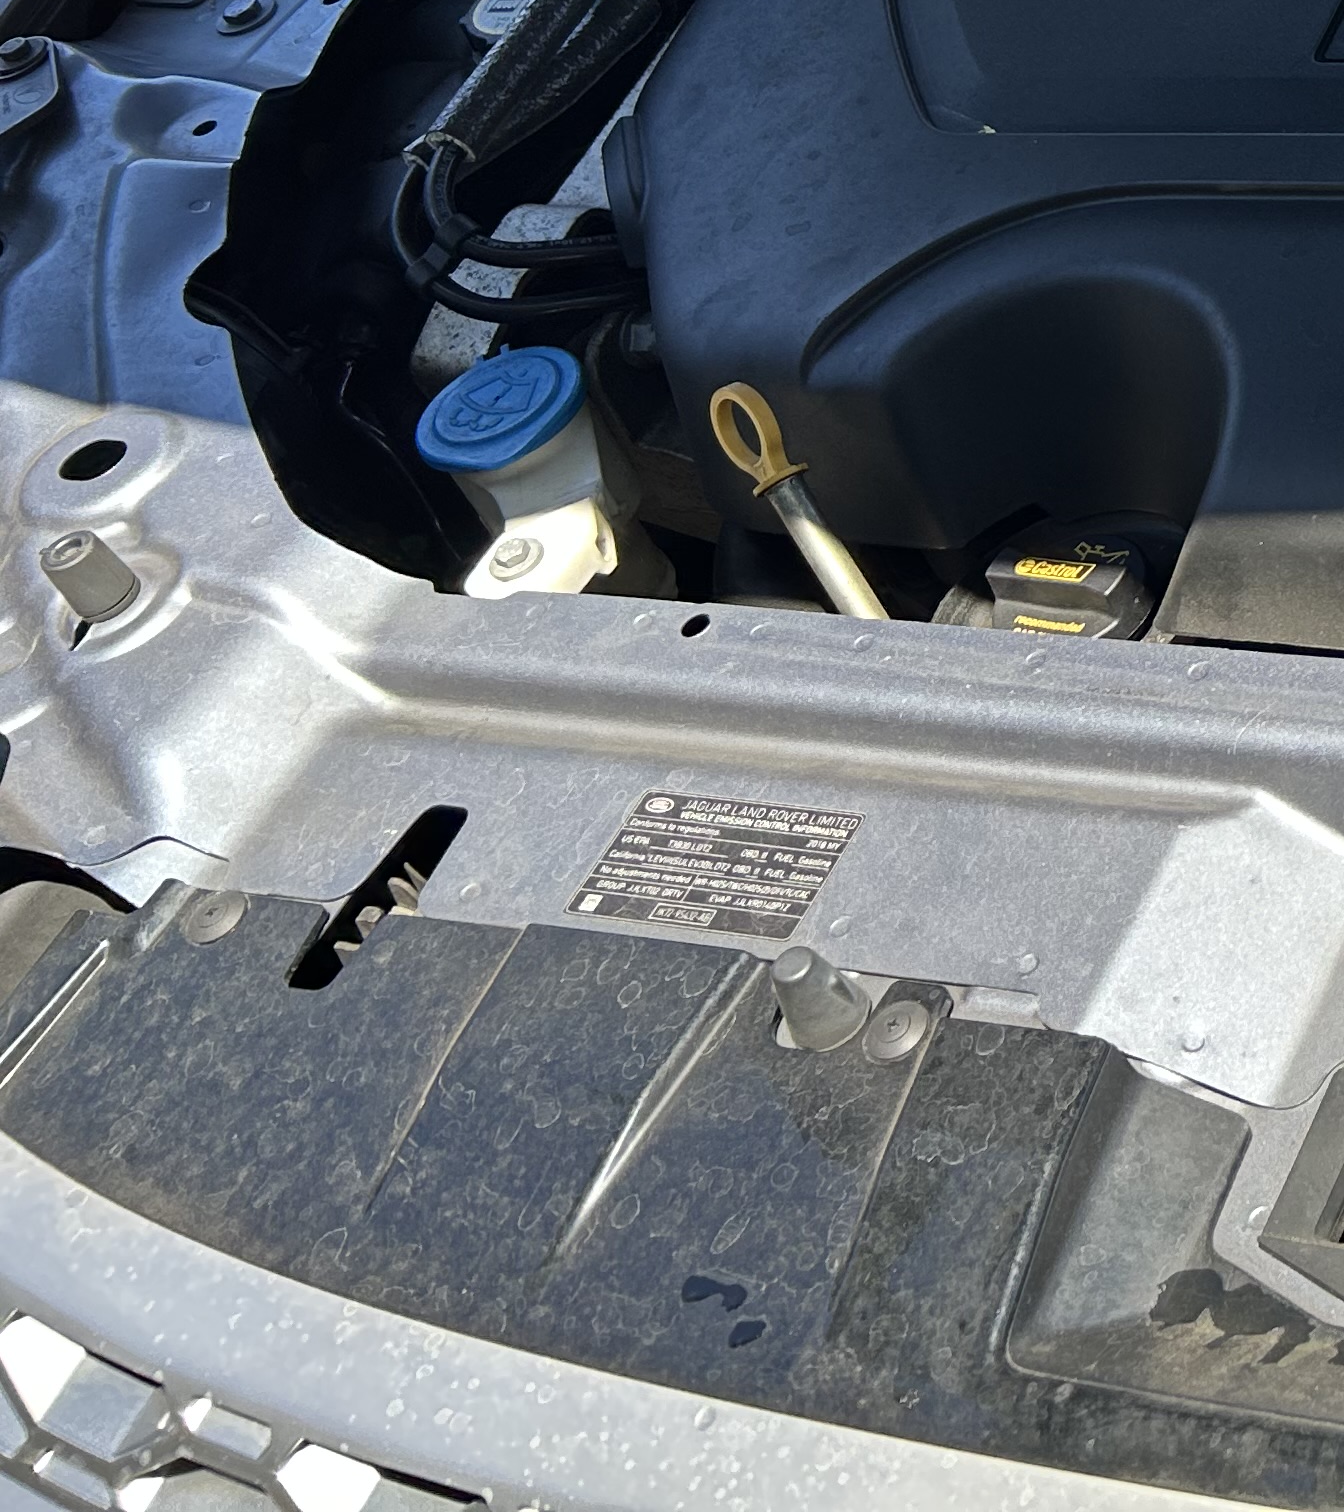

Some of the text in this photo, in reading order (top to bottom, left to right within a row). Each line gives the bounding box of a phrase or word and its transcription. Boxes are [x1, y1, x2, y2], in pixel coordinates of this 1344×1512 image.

[1032, 561, 1084, 578] Castrol
[681, 799, 731, 814] JAGUAR
[731, 803, 766, 819] LAND
[766, 808, 808, 824] ROVER
[809, 813, 859, 830] LIMITED
[628, 818, 722, 837] Conforms to regulations
[680, 812, 849, 838] VEHICLE EMISSION CONTROL INFORMATION
[620, 834, 635, 842] US
[771, 852, 796, 862] FUEL
[796, 855, 833, 867] Gasoline
[825, 841, 841, 850] MY
[598, 864, 693, 883] No adjustments needed
[762, 868, 788, 878] FUEL
[787, 871, 825, 883] Gasoline
[594, 879, 628, 891] GROUP
[707, 893, 732, 904] EVAP
